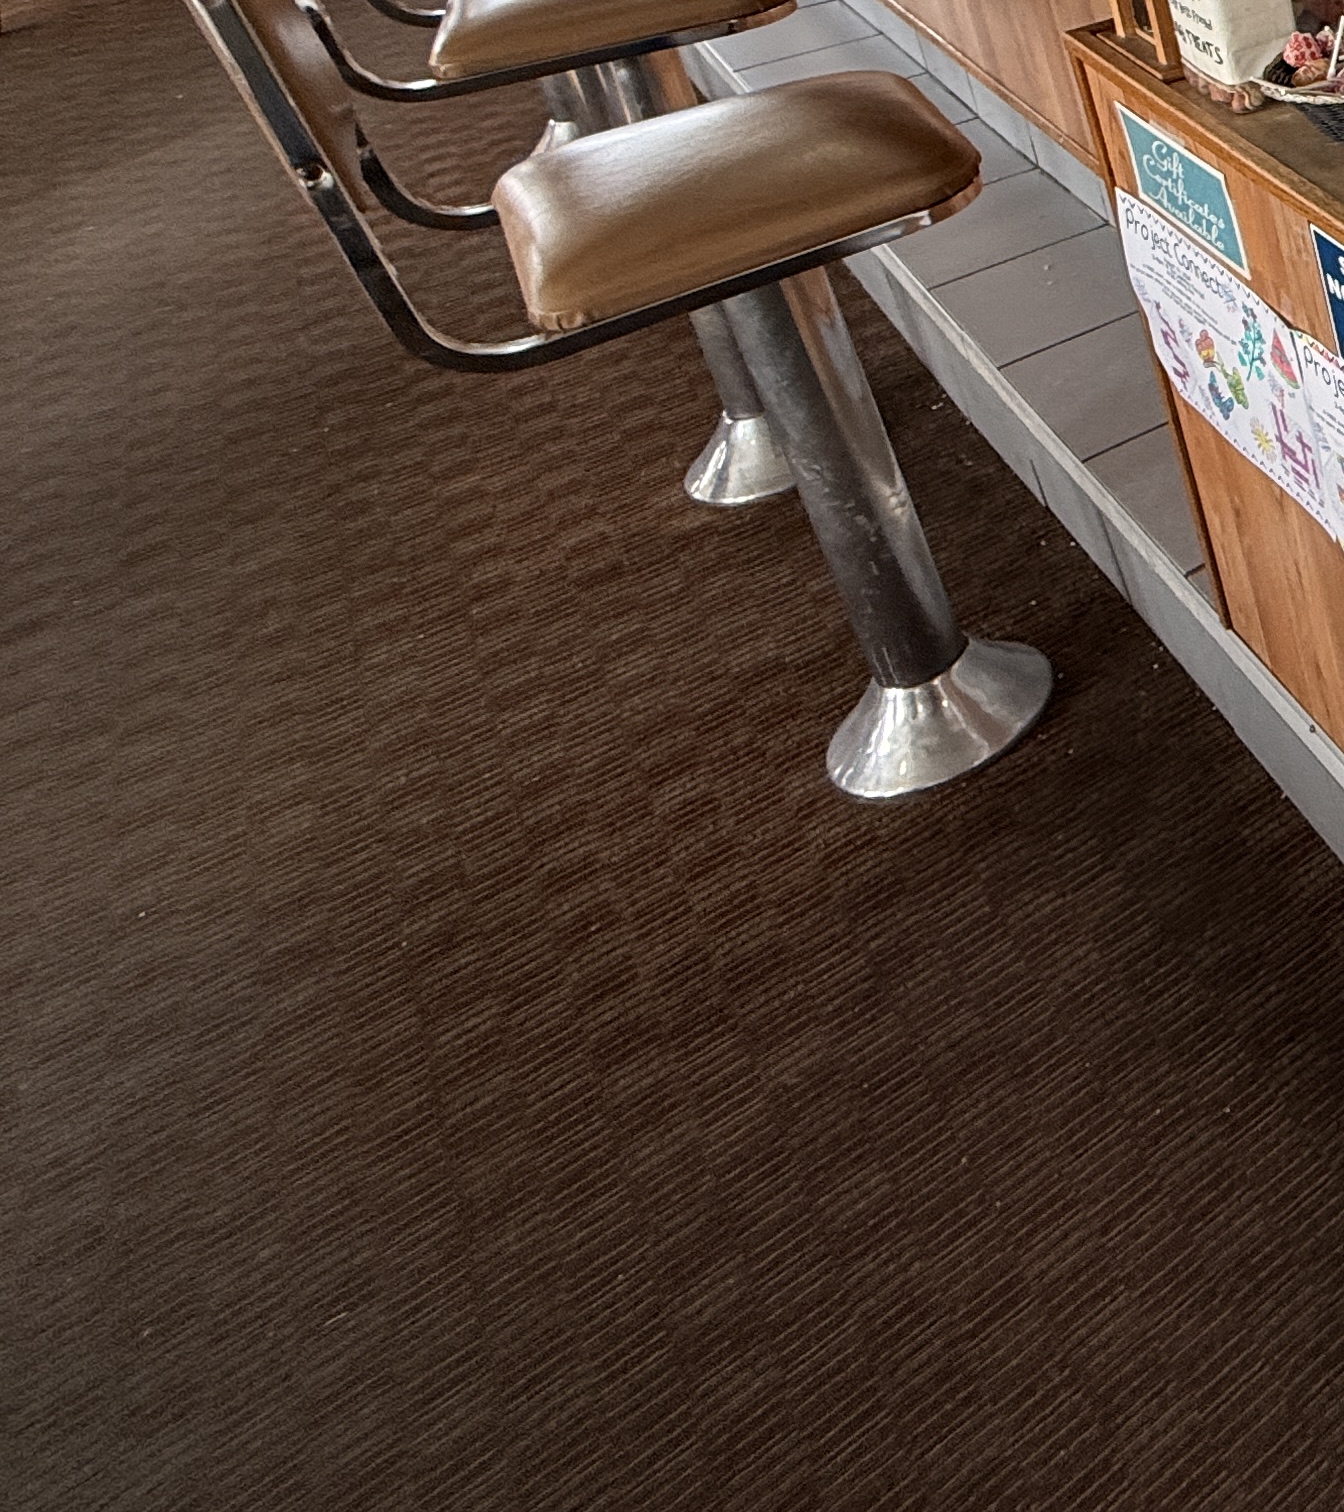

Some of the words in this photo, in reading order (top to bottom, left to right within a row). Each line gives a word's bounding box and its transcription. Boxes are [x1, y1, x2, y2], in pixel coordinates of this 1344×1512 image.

[1143, 154, 1225, 230] Certificates
[1152, 140, 1184, 179] Gift
[1125, 207, 1172, 258] Project
[1173, 242, 1224, 299] Connect
[1148, 186, 1225, 251] Available
